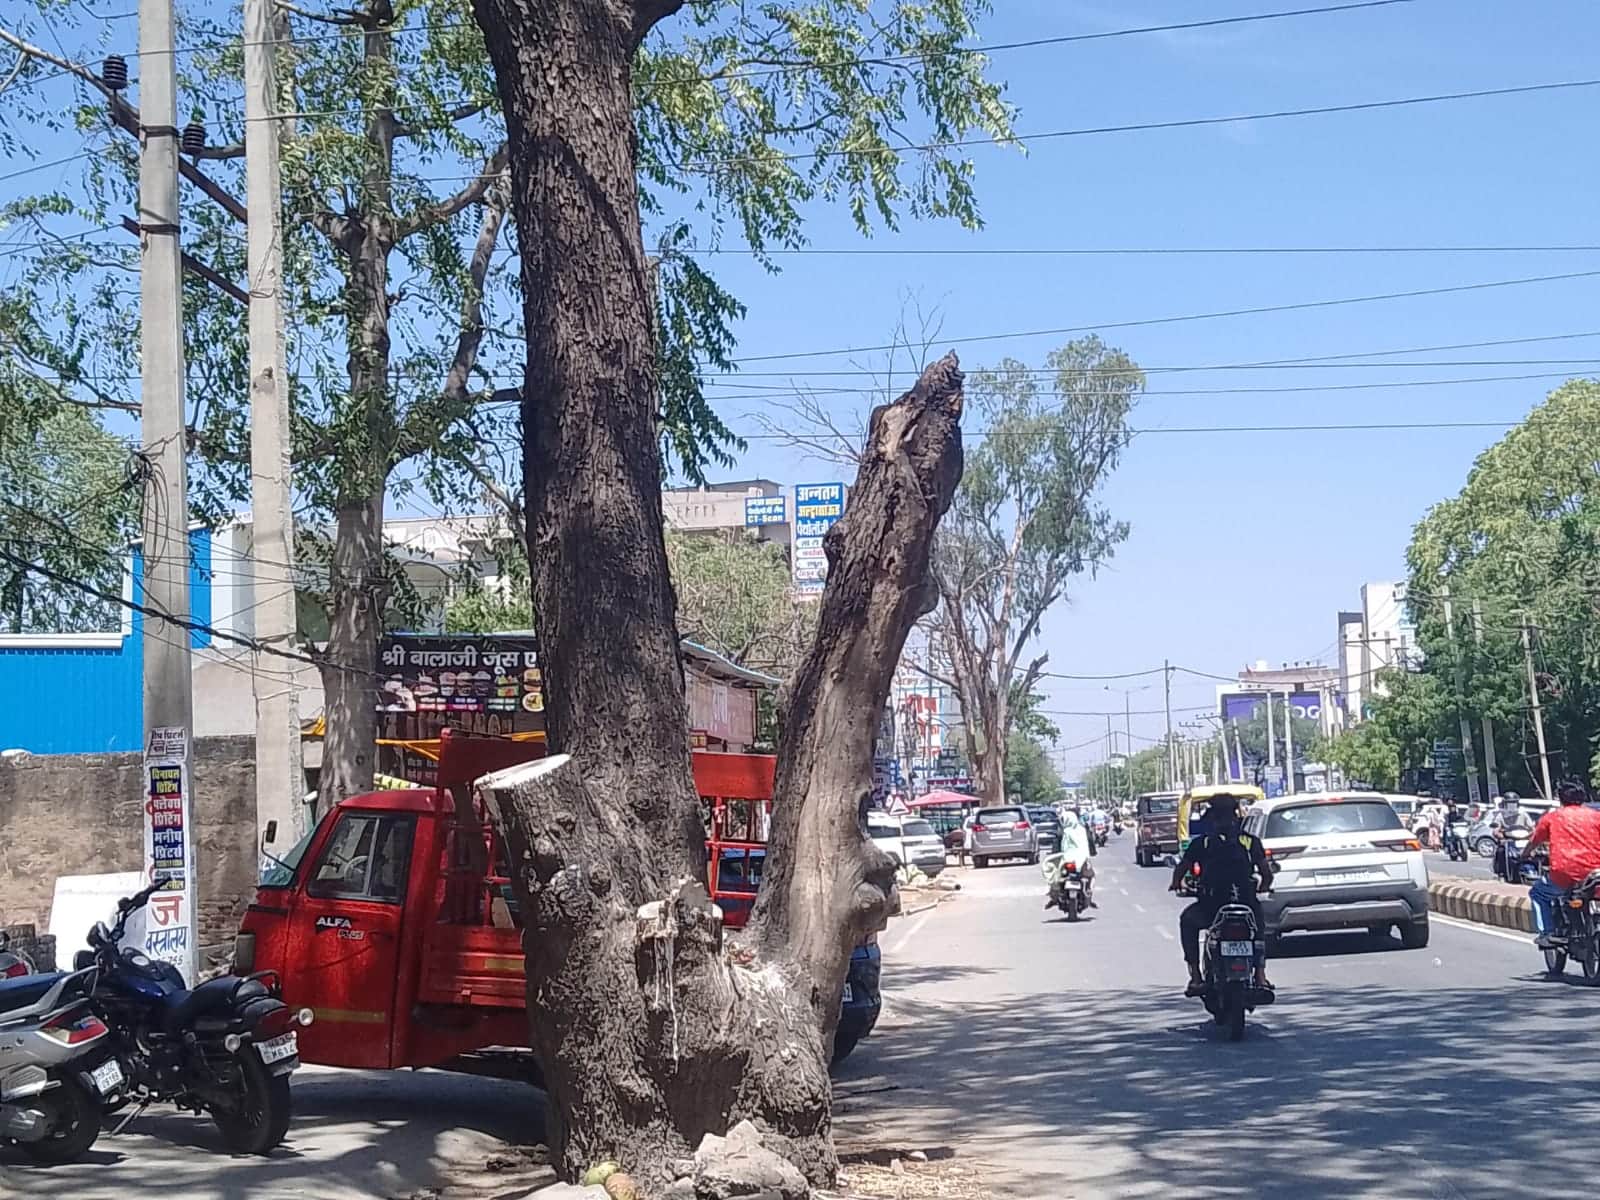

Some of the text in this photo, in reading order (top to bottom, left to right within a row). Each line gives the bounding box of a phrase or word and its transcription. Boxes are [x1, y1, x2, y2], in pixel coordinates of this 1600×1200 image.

[382, 645, 406, 666] श्री
[410, 645, 478, 667] बालाजी
[316, 916, 352, 928] ALFA
[146, 926, 189, 956] वस्त्रालय
